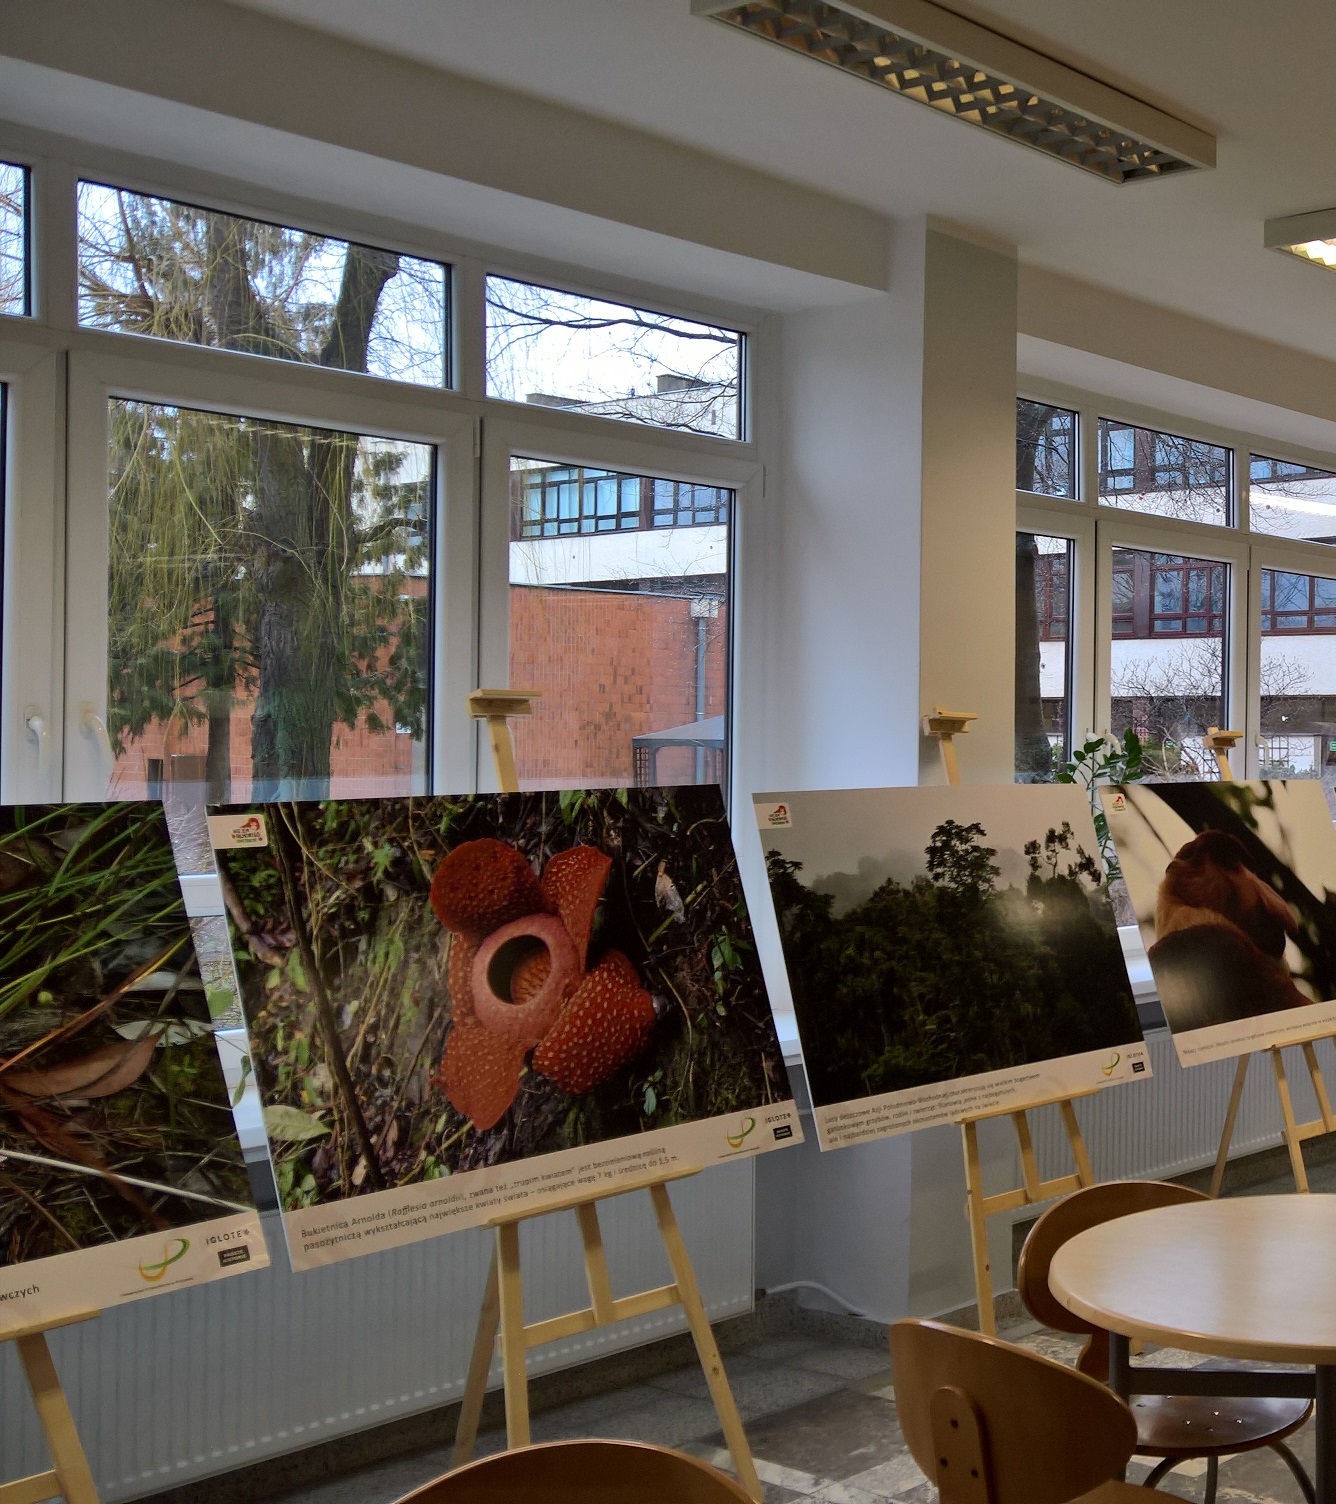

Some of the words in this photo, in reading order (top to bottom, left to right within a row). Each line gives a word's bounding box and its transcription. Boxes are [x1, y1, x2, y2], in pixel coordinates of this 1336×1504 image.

[301, 1220, 349, 1238] Bukietnica
[351, 1212, 386, 1226] Arnolda
[469, 1188, 494, 1199] zwana
